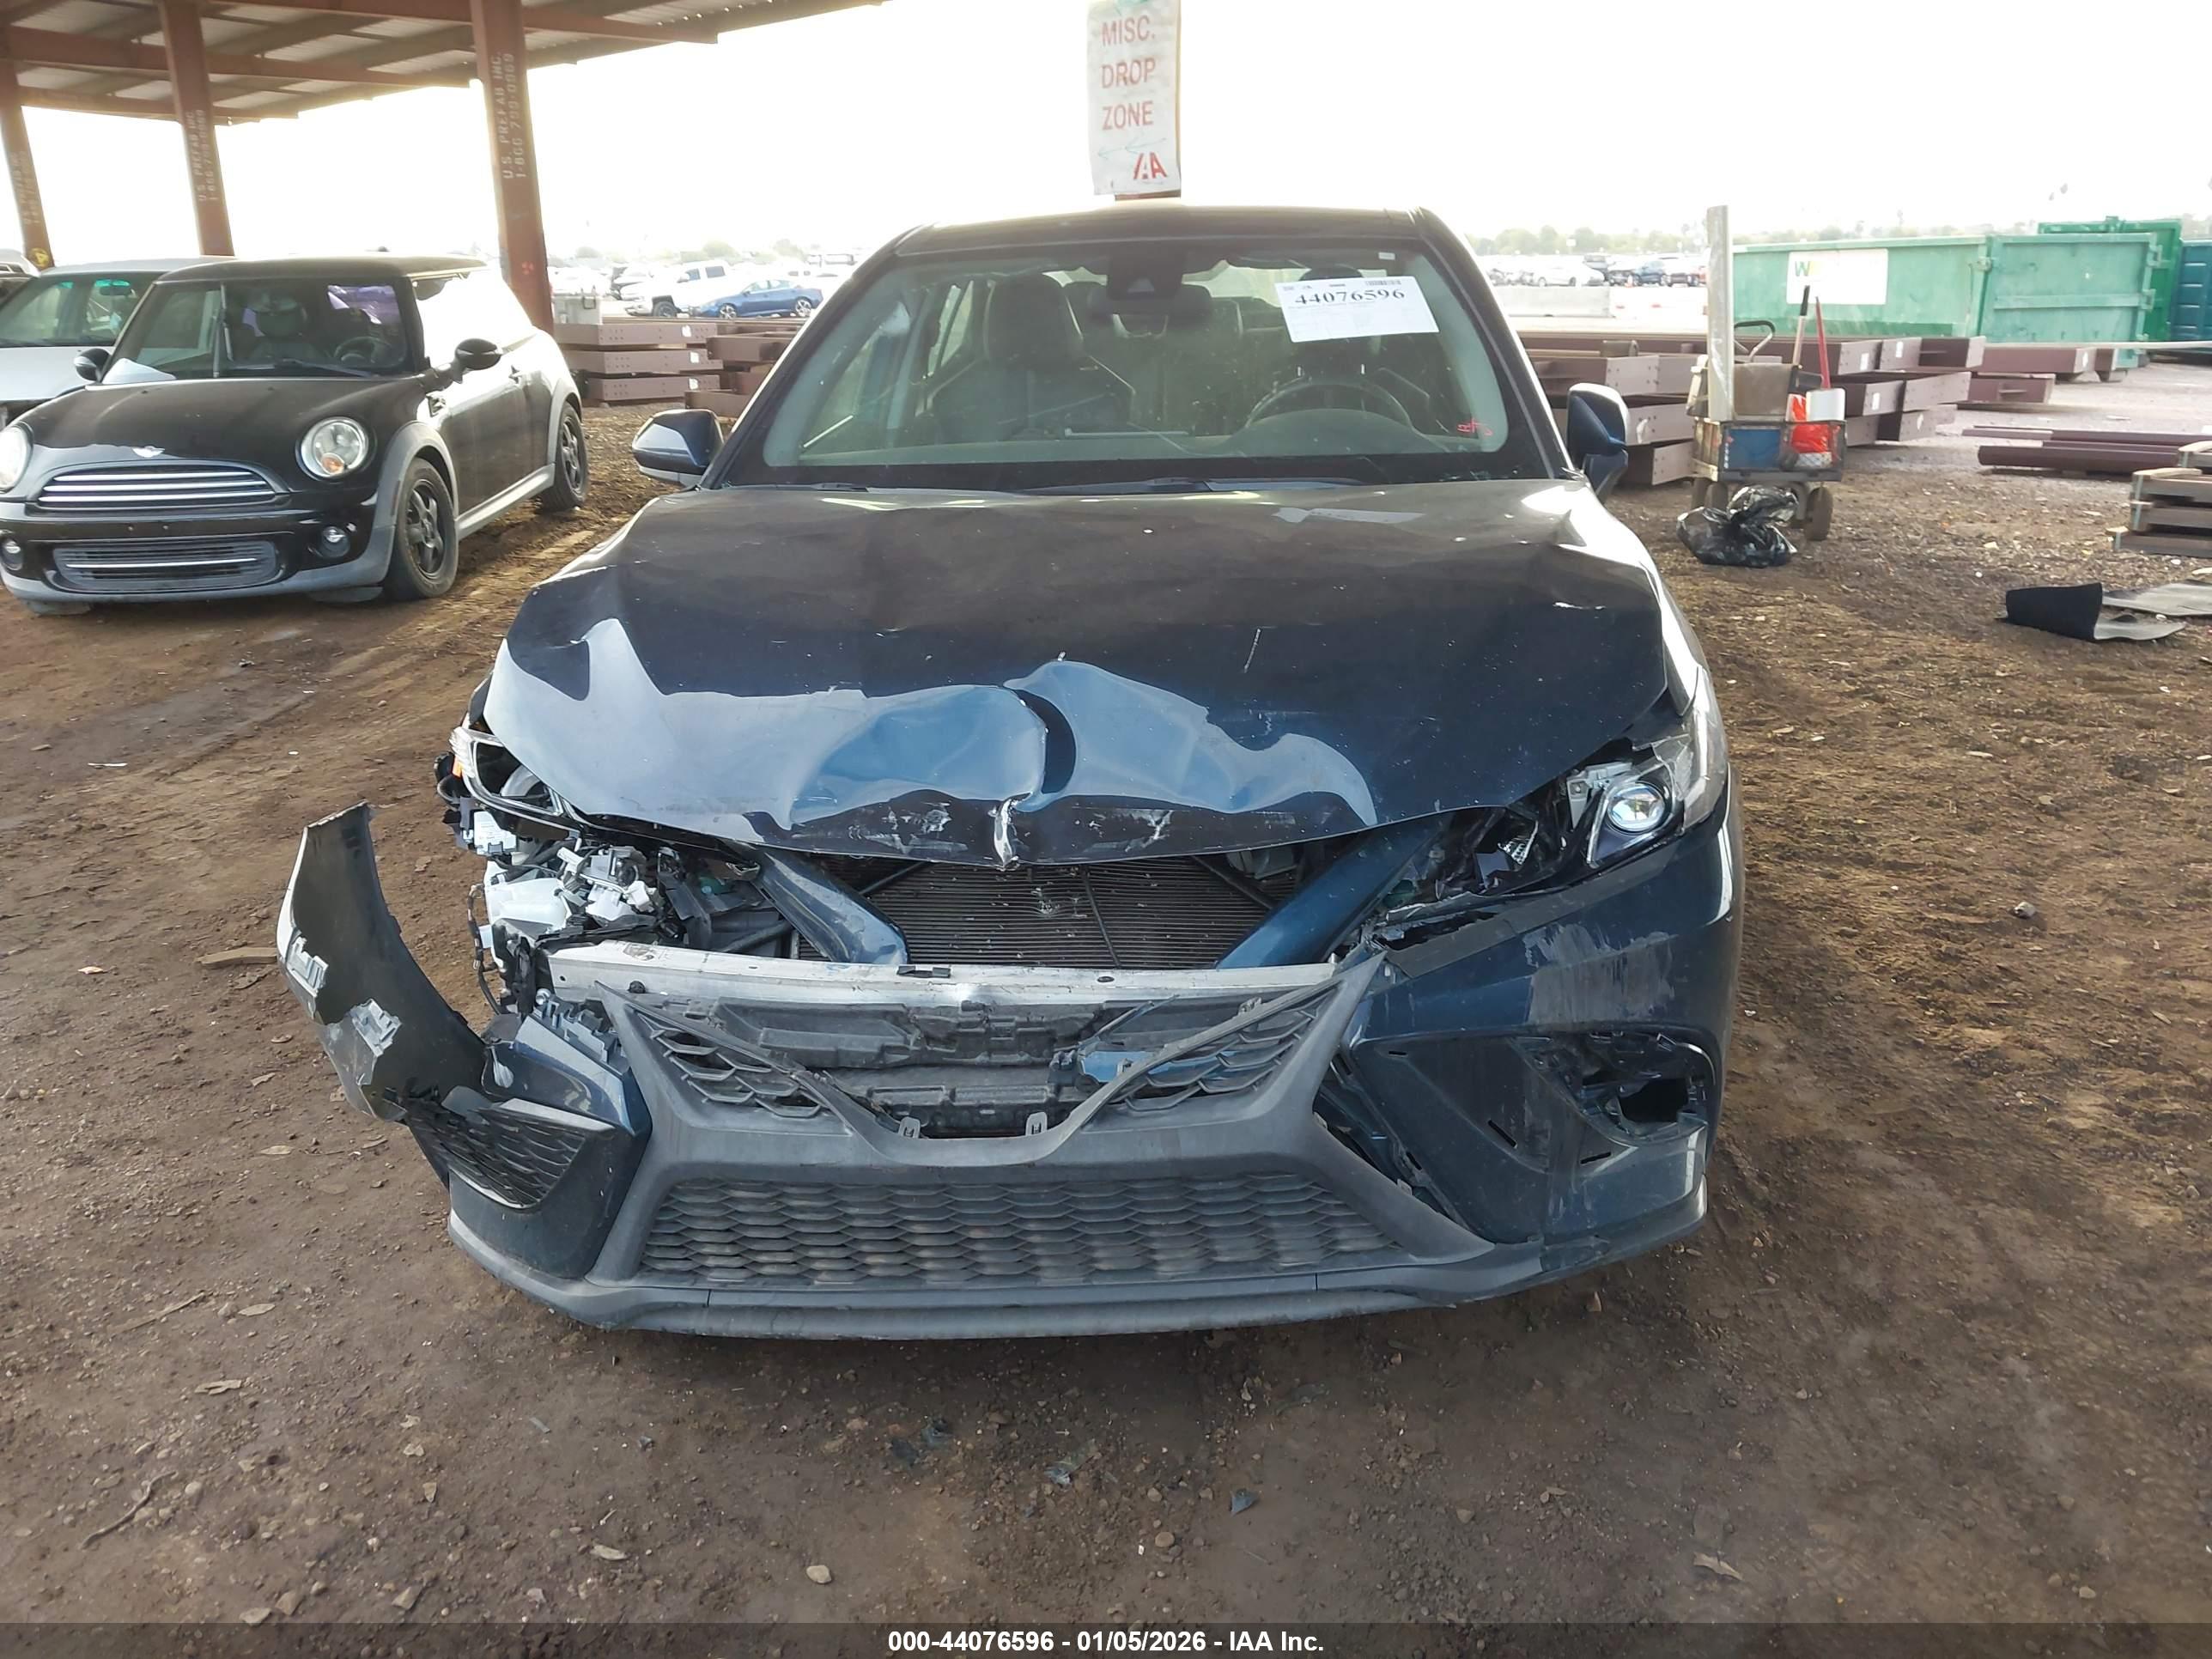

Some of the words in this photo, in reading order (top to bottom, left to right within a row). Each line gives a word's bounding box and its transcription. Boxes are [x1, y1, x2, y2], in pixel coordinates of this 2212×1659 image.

[1102, 15, 1155, 46] MISC.
[1102, 58, 1156, 88] DROP
[1102, 100, 1154, 131] ZONE
[1295, 289, 1405, 304] 44076596
